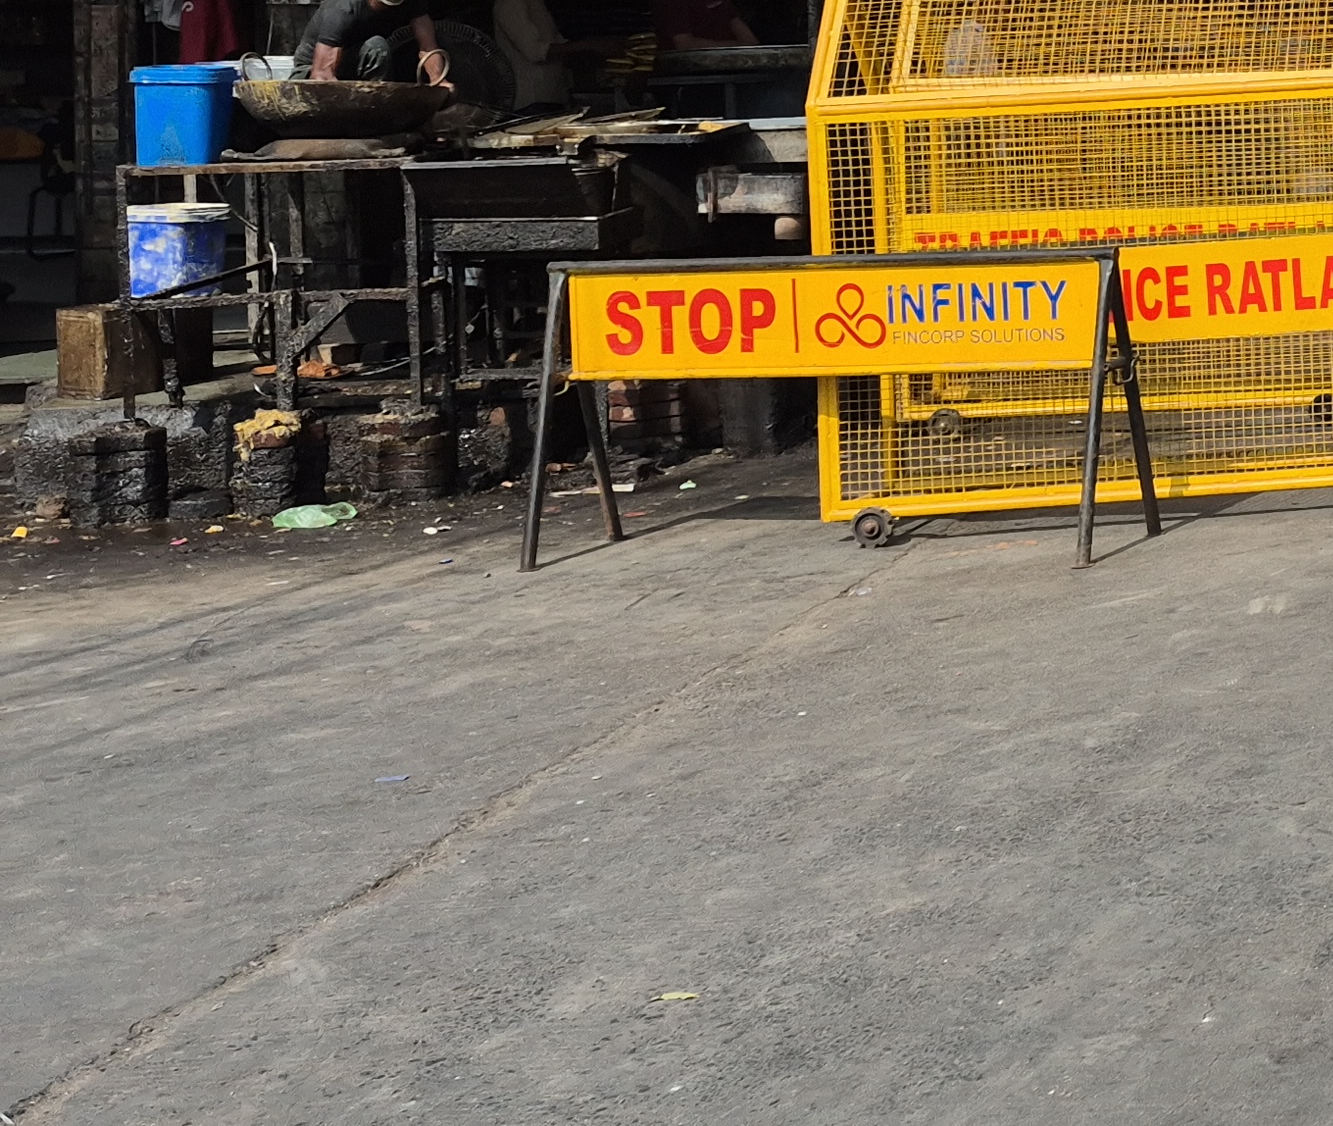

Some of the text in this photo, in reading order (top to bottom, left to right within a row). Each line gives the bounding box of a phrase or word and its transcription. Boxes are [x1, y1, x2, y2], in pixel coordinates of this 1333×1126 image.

[604, 287, 777, 357] STOP
[886, 279, 1068, 325] INFINITY
[892, 326, 1066, 346] FINCORP SOLUTIONS
